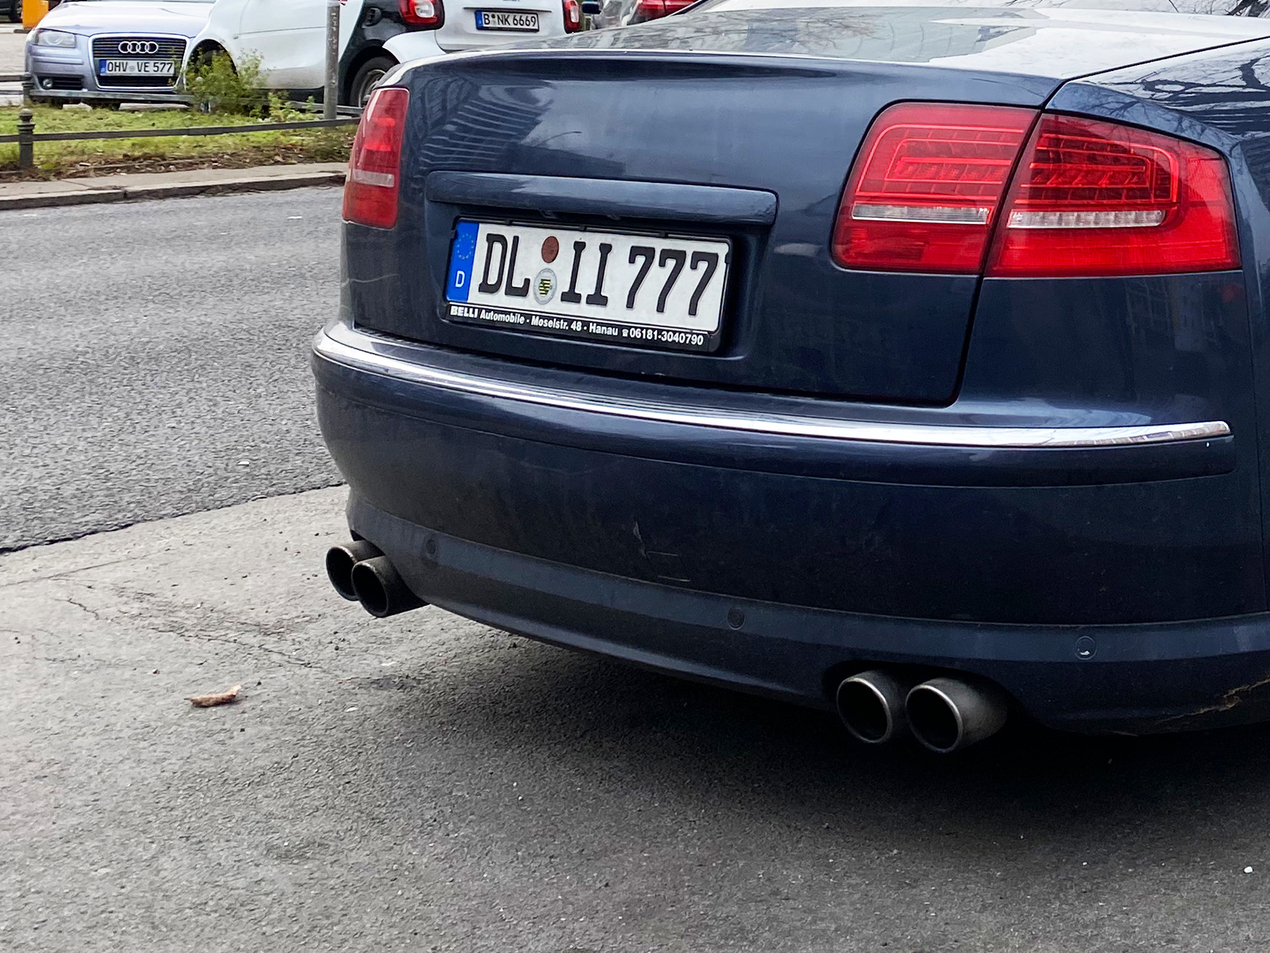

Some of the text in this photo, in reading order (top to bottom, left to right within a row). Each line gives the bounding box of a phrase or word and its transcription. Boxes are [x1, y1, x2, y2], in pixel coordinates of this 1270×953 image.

[483, 13, 537, 27] B NK 6669
[107, 62, 128, 73] OHV
[136, 62, 150, 73] VE
[153, 62, 173, 73] 577
[455, 270, 465, 289] D
[477, 233, 719, 316] DL II 777
[450, 305, 703, 346] BELLI Automobile Moselstr. 48 Hanau 06181-3040790
